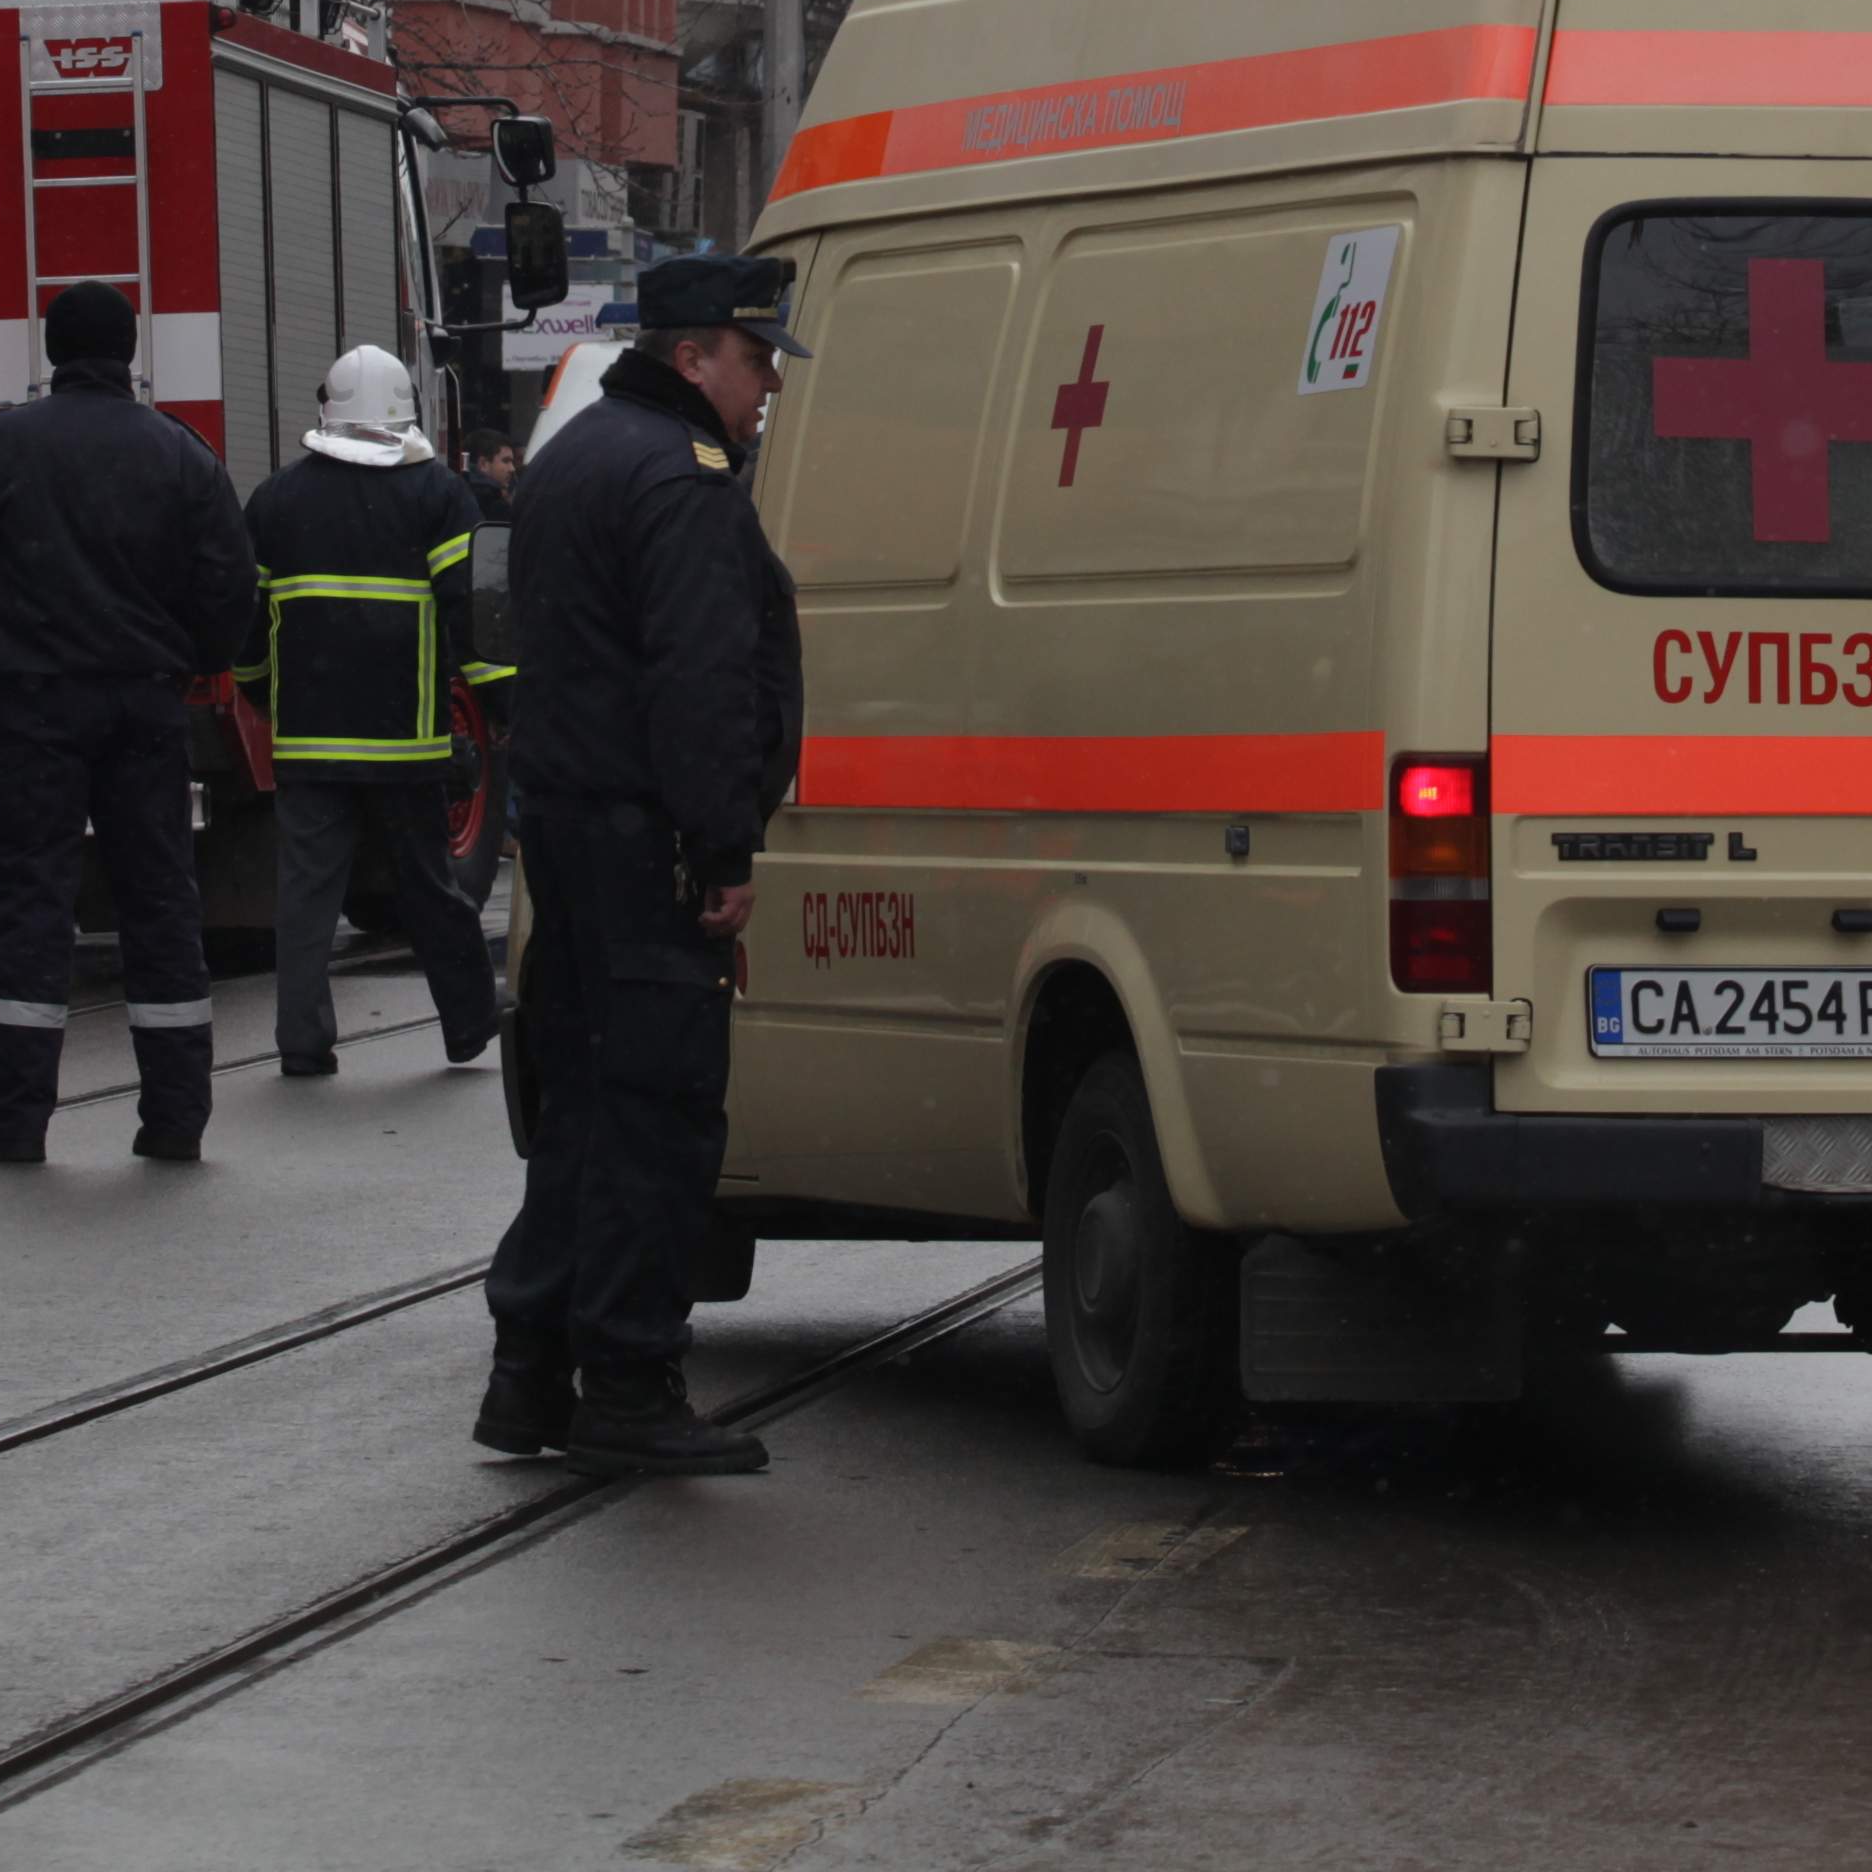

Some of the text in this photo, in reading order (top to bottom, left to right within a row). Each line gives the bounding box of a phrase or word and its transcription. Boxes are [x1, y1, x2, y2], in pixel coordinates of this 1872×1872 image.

[960, 79, 1188, 157] МЕДИЦИНСКА ПОМОЩ
[1330, 300, 1376, 360] 112
[1552, 832, 1757, 861] TRANSIT L
[802, 891, 915, 970] СД-СУПБЗН
[1597, 1016, 1621, 1034] BG
[1638, 1047, 1690, 1056] AUTOHAUS
[1694, 1047, 1740, 1056] POTSDAM
[1745, 1047, 1760, 1056] AM
[1764, 1047, 1793, 1056] STERN
[1810, 1047, 1855, 1056] POTSDAM
